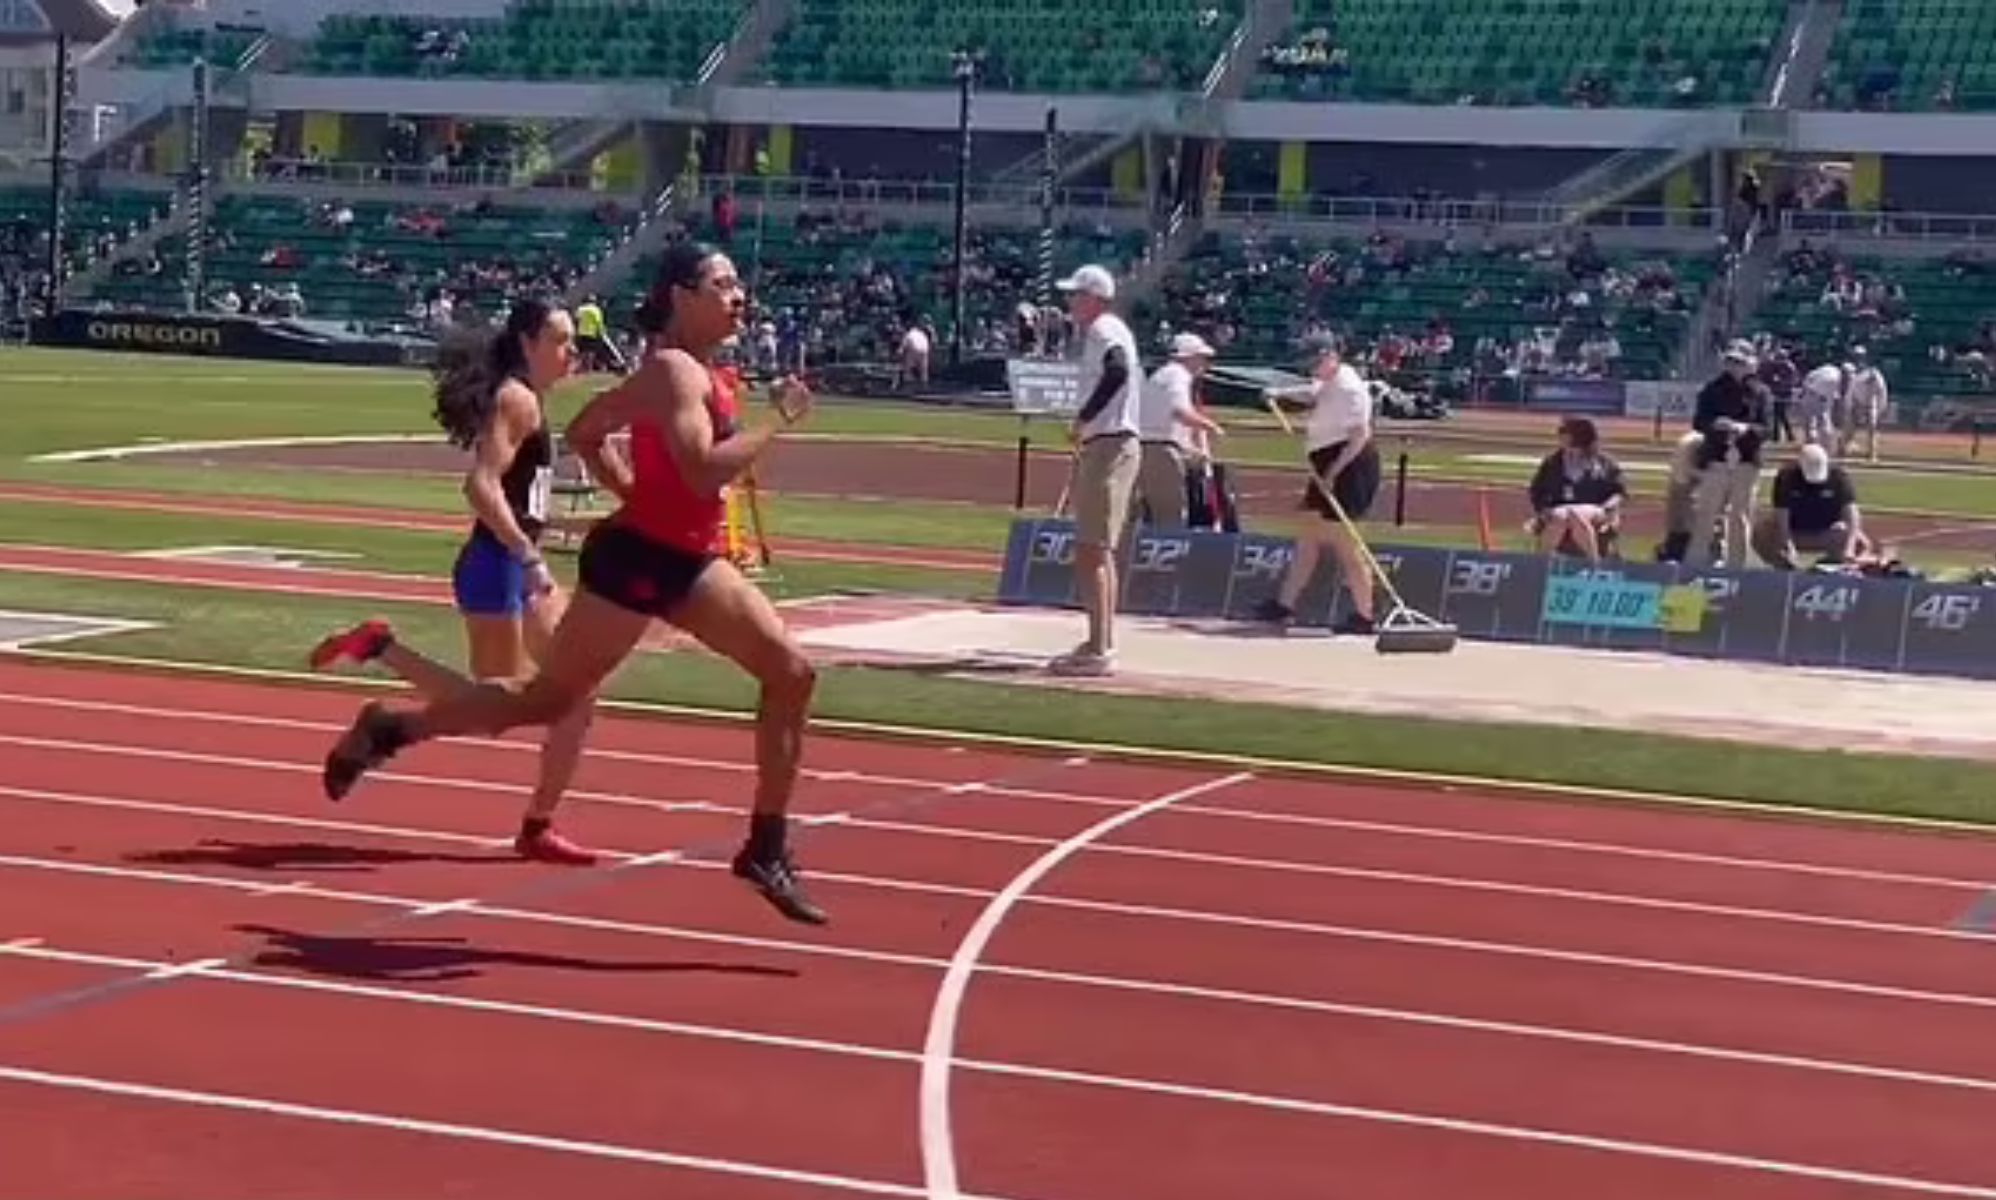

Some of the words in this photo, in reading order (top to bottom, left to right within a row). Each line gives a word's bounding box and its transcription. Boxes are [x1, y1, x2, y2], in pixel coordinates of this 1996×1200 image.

[1131, 538, 1190, 571] 32'
[1449, 560, 1511, 595] 38'
[1795, 585, 1860, 621] 44'
[1911, 594, 1980, 629] 46'
